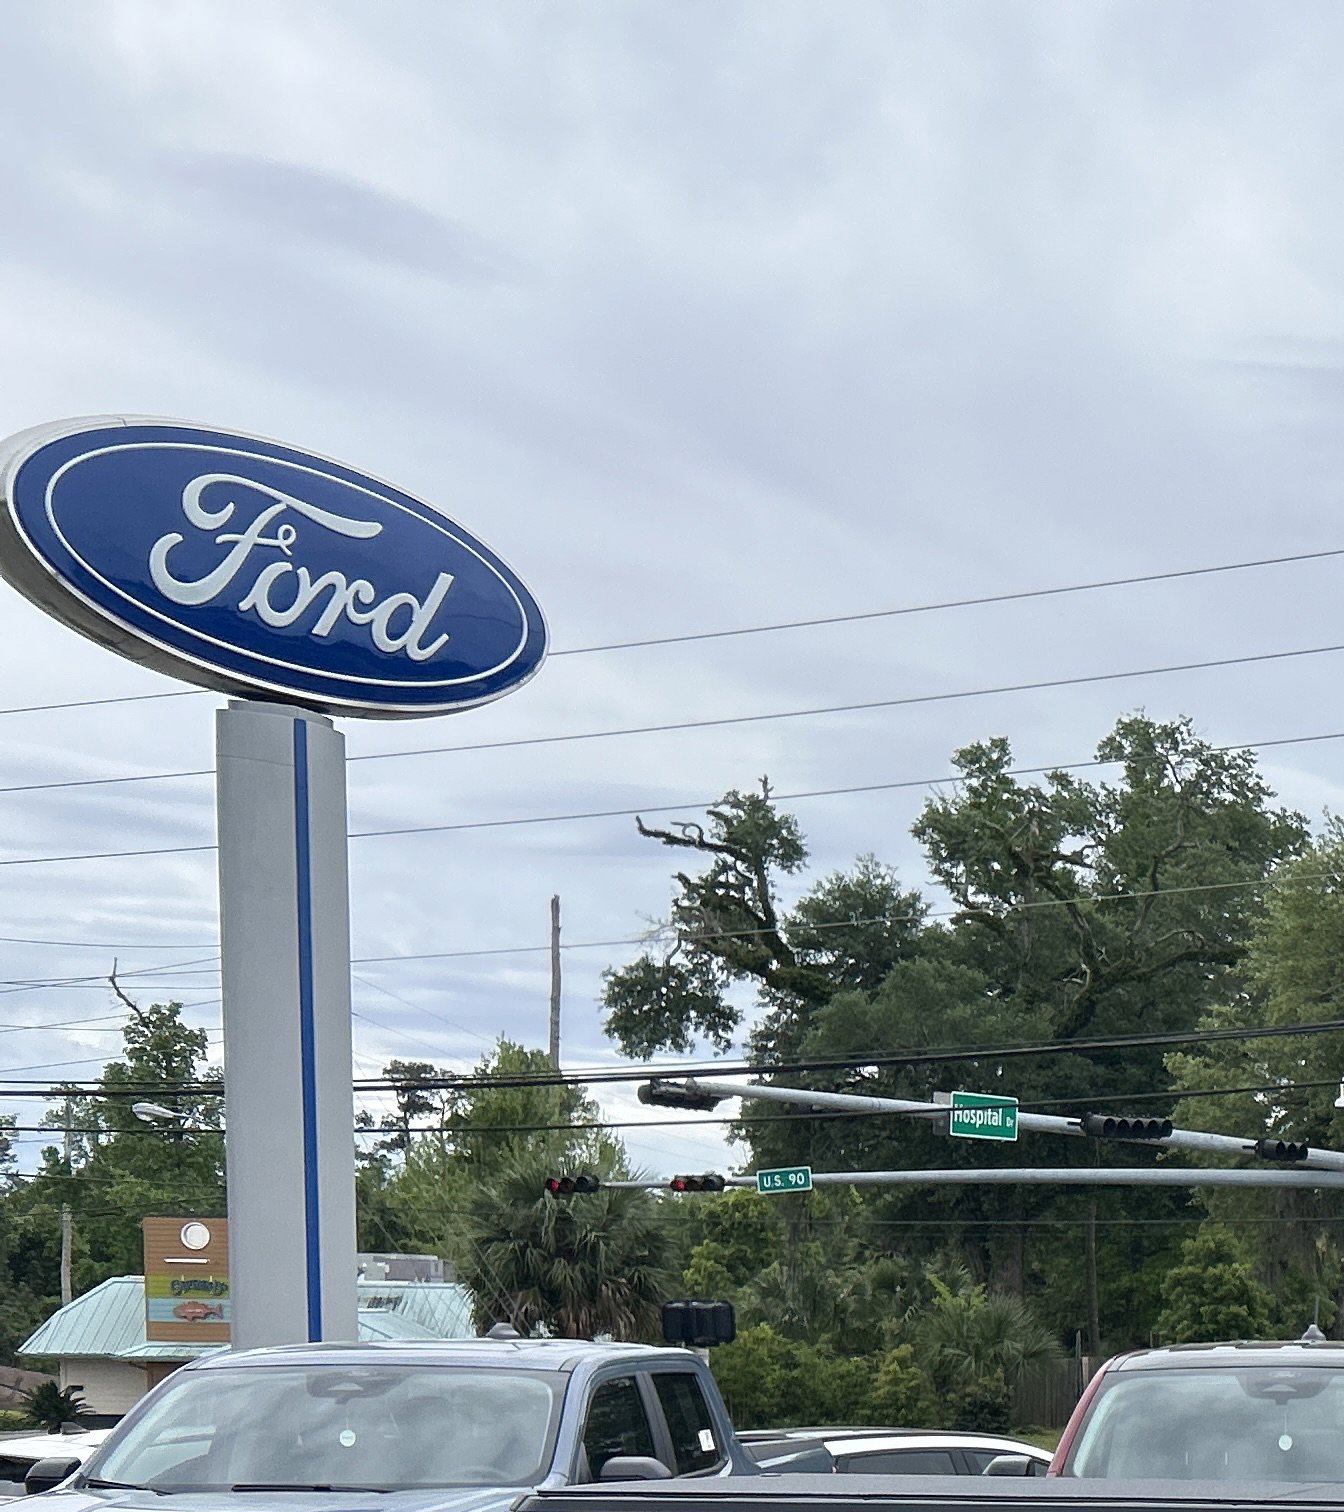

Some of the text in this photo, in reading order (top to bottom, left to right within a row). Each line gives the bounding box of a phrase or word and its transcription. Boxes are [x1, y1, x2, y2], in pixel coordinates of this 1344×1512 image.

[149, 473, 454, 661] Ford
[763, 1172, 805, 1188] U.S. 90
